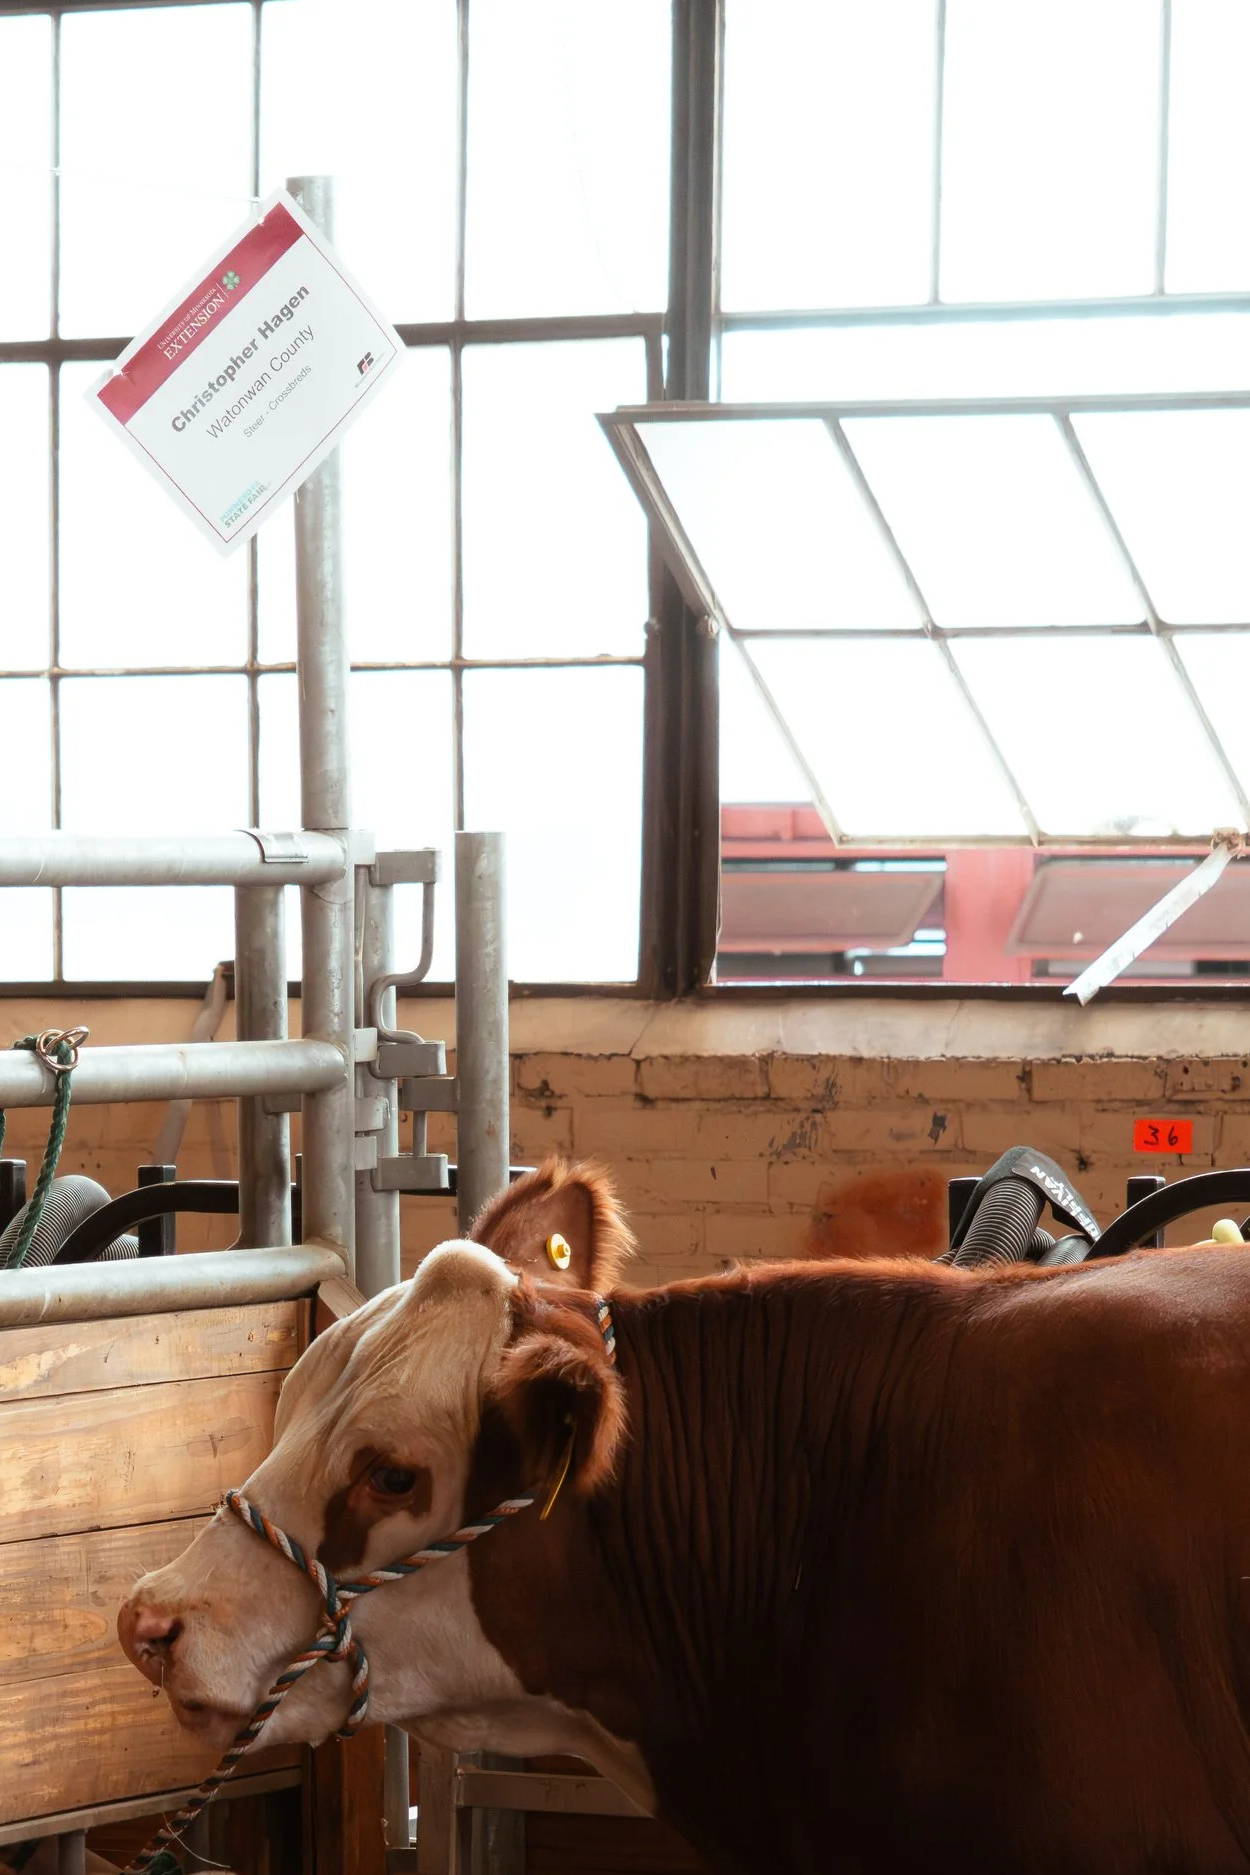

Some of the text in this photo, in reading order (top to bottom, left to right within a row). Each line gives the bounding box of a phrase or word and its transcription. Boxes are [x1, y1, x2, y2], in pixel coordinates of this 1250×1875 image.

[163, 294, 225, 360] EXTENSION
[171, 285, 310, 434] Christopher Hagen
[207, 324, 315, 439] Watonwan County
[243, 414, 265, 438] Steer
[268, 365, 312, 411] Crossbreds
[224, 485, 268, 528] STATE FAIR
[1030, 1166, 1100, 1242] ULLIVAN
[1052, 1176, 1103, 1237] UPPLY
